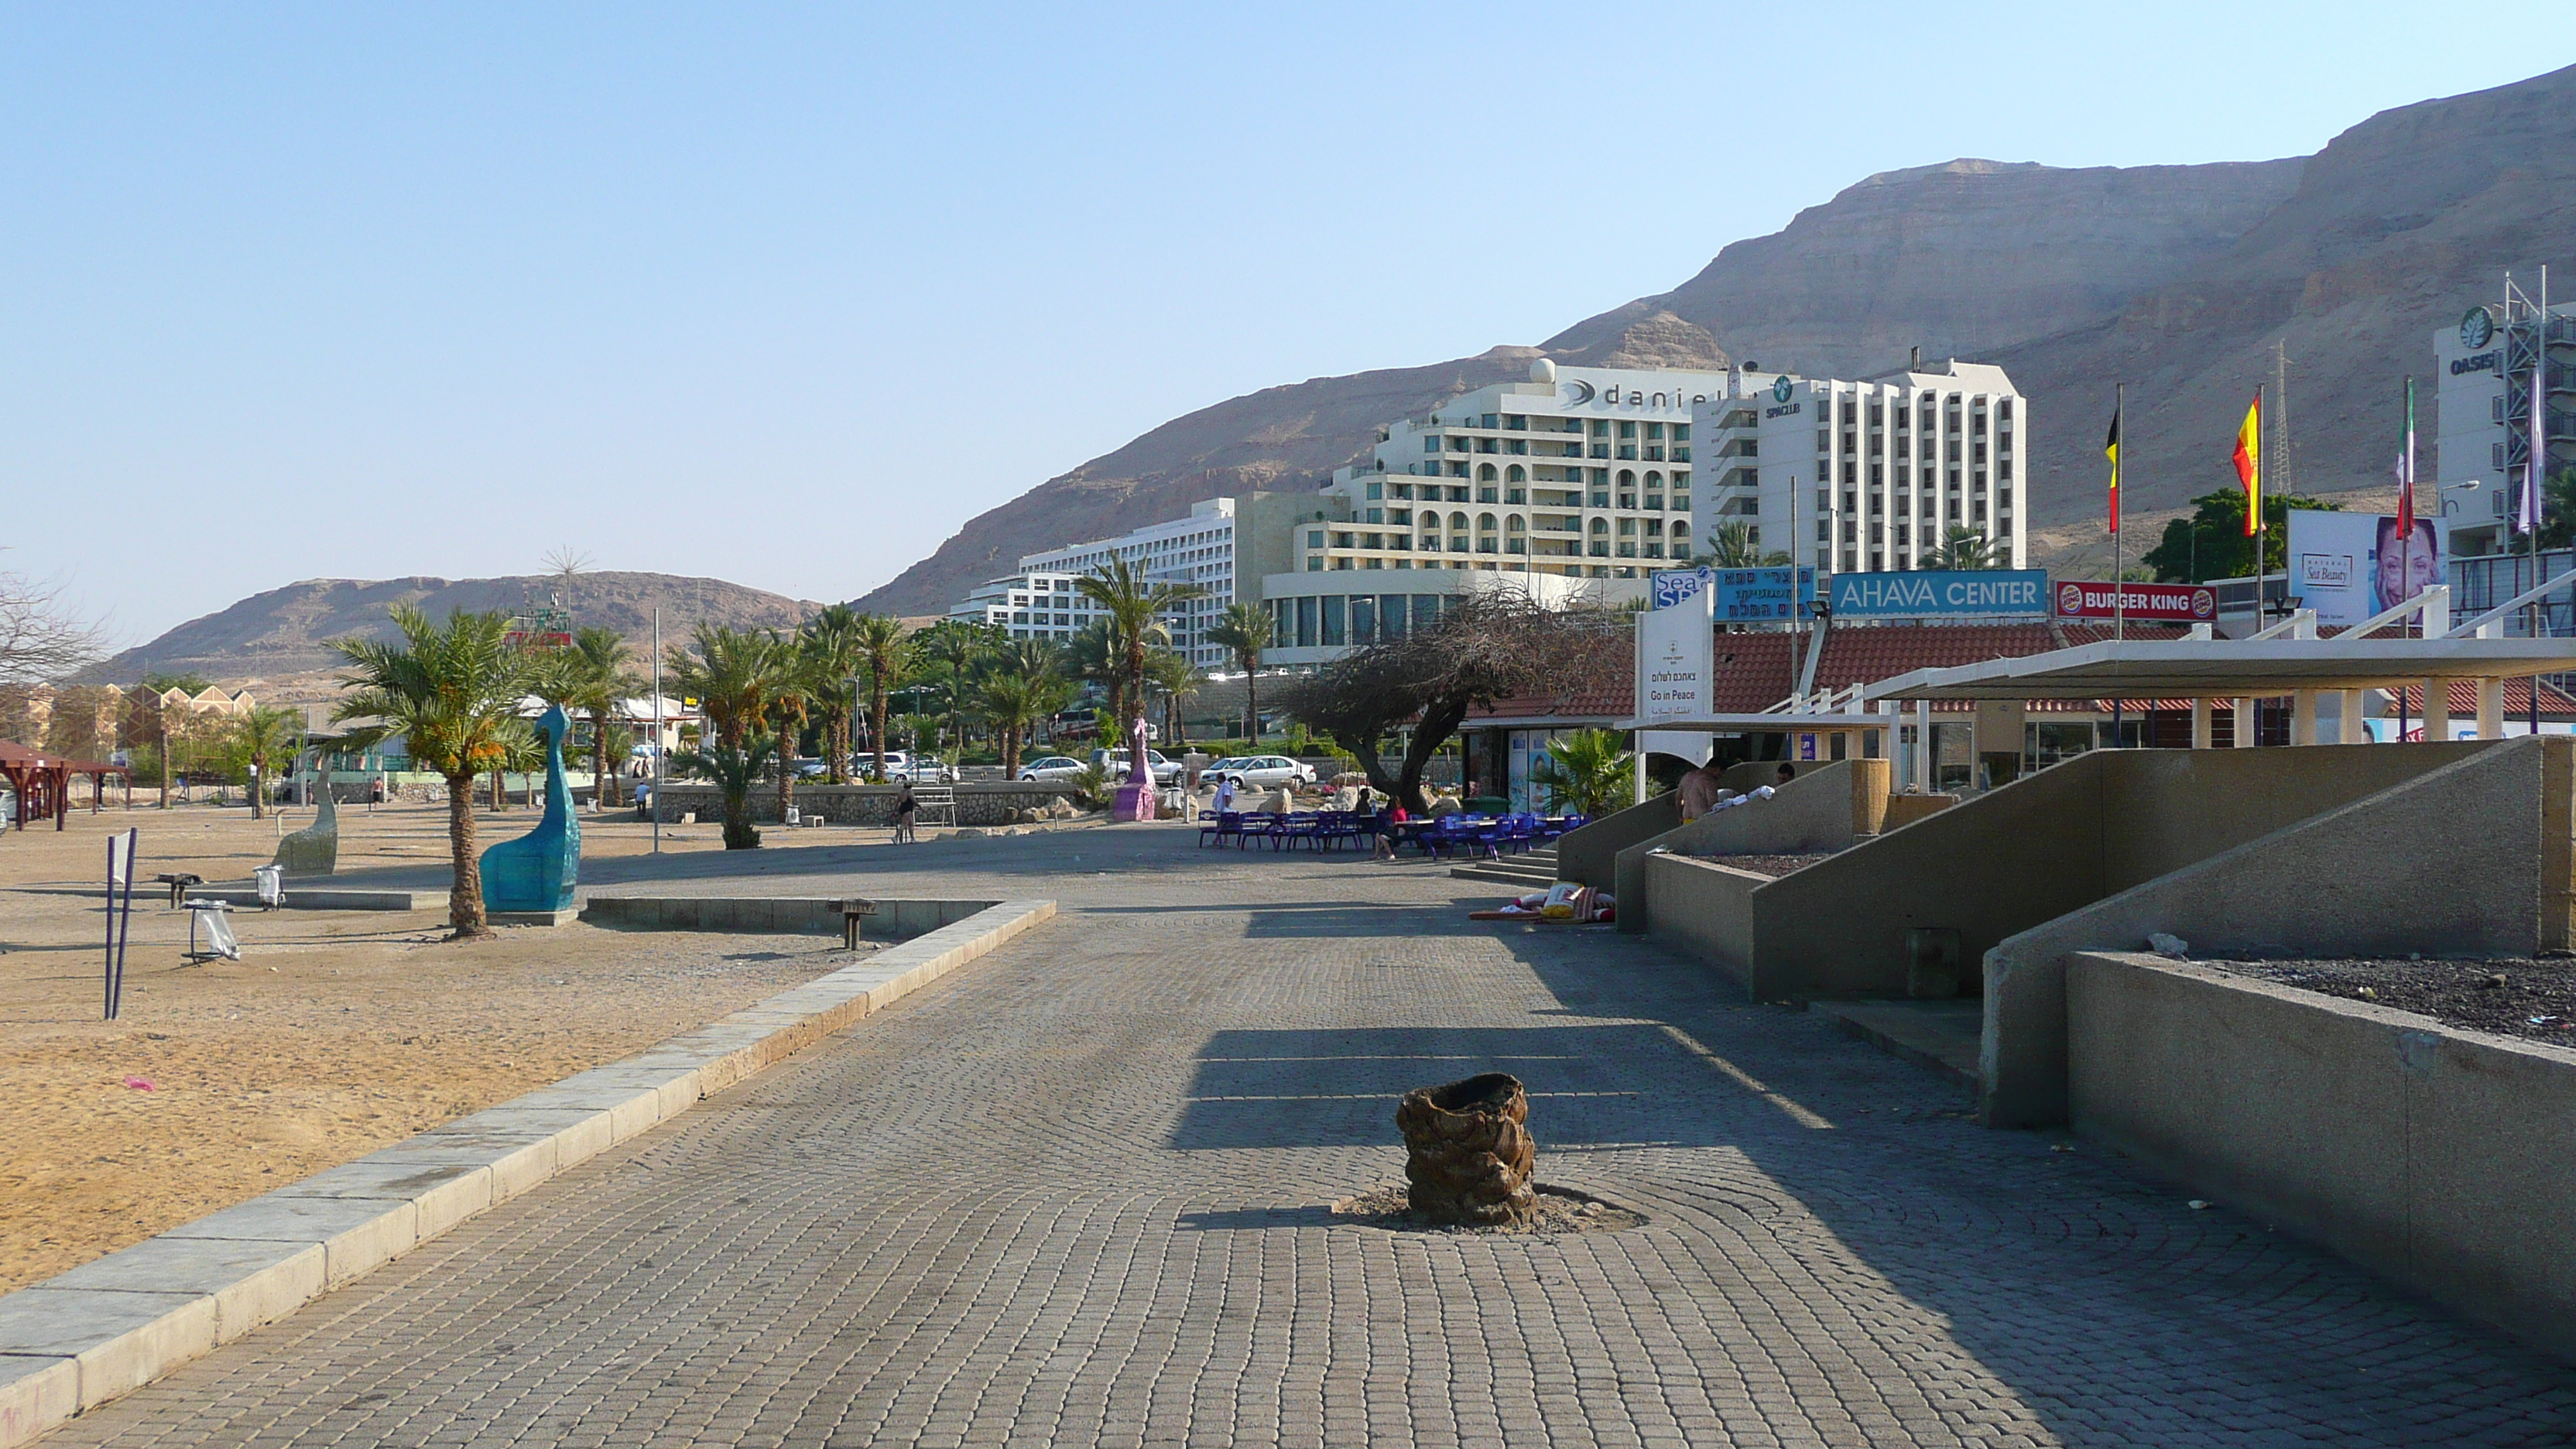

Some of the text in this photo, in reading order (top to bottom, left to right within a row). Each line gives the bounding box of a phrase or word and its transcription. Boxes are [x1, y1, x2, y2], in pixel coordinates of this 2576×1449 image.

[1605, 384, 1721, 408] daniel
[1657, 574, 1697, 591] Sea
[2307, 567, 2347, 584] Sea Beauty
[1840, 578, 2036, 608] AHAVA CENTER
[2085, 592, 2189, 611] BURGER KING
[1651, 690, 1695, 701] Go in Peace
